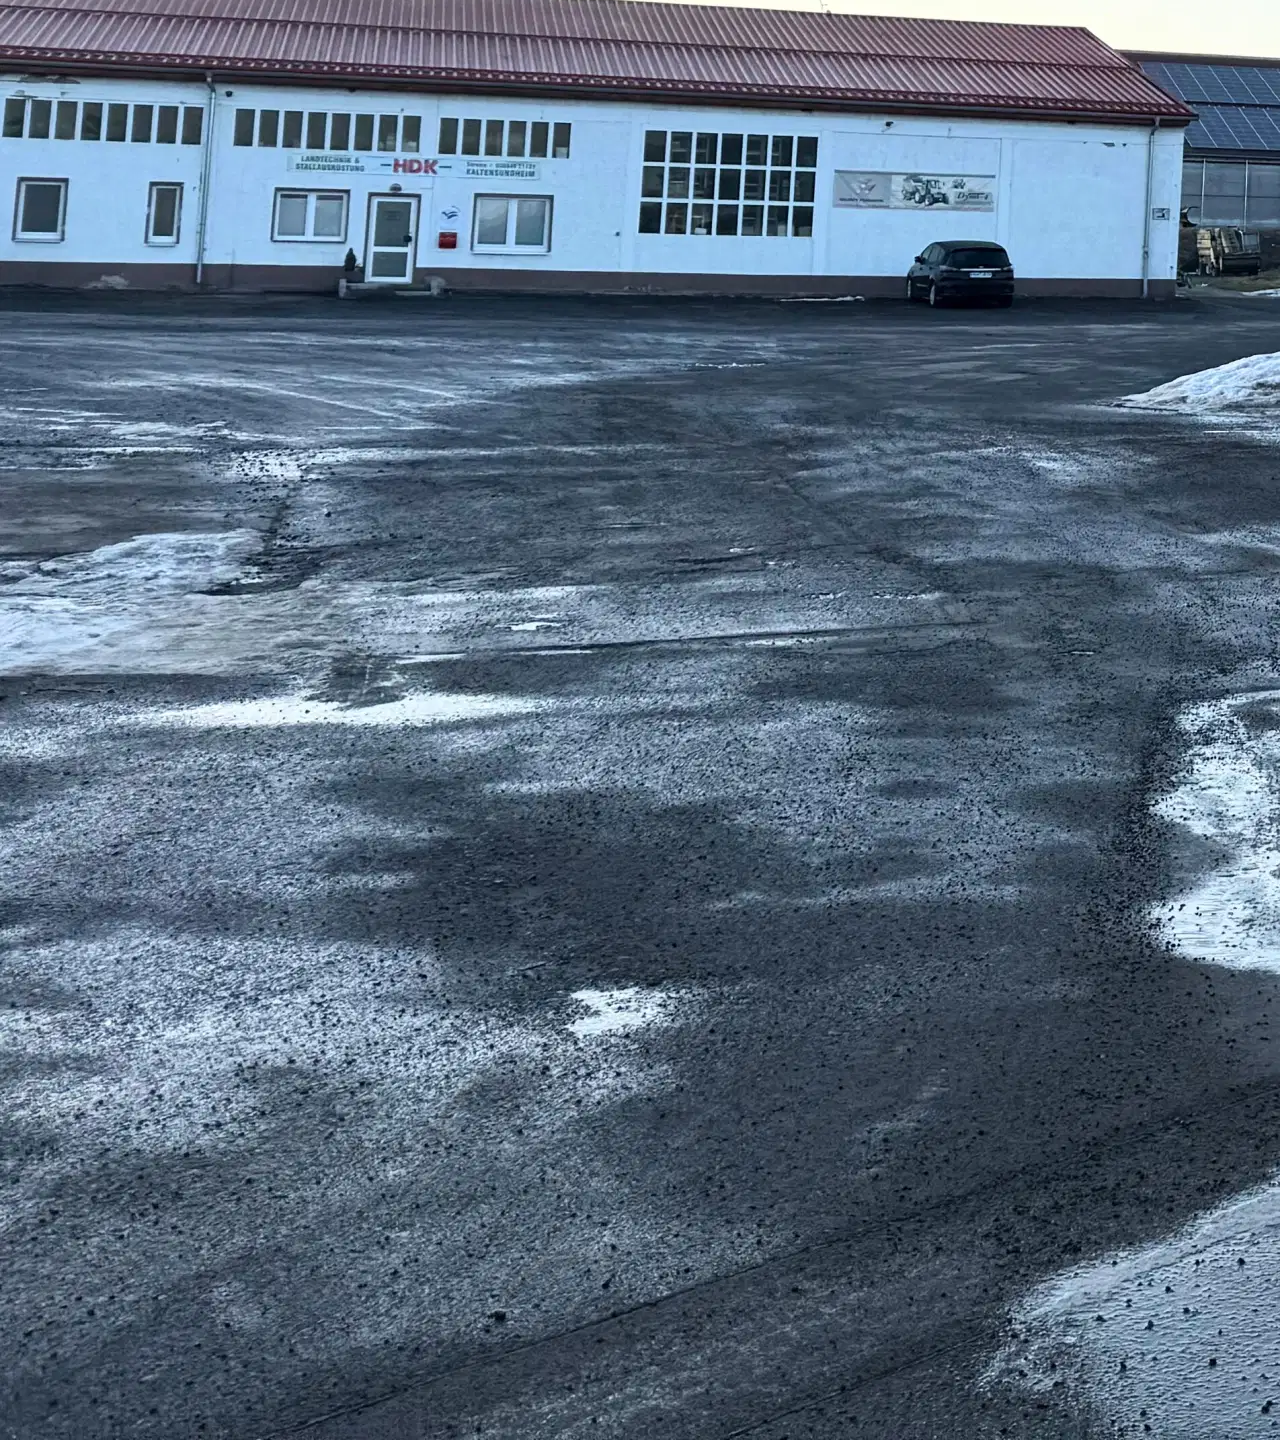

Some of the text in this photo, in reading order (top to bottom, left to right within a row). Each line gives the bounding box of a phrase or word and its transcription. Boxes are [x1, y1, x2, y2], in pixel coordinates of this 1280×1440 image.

[301, 155, 351, 163] LANDTECHNIK
[392, 158, 439, 175] HDK
[466, 168, 535, 177] KALTENSUNDHEIM
